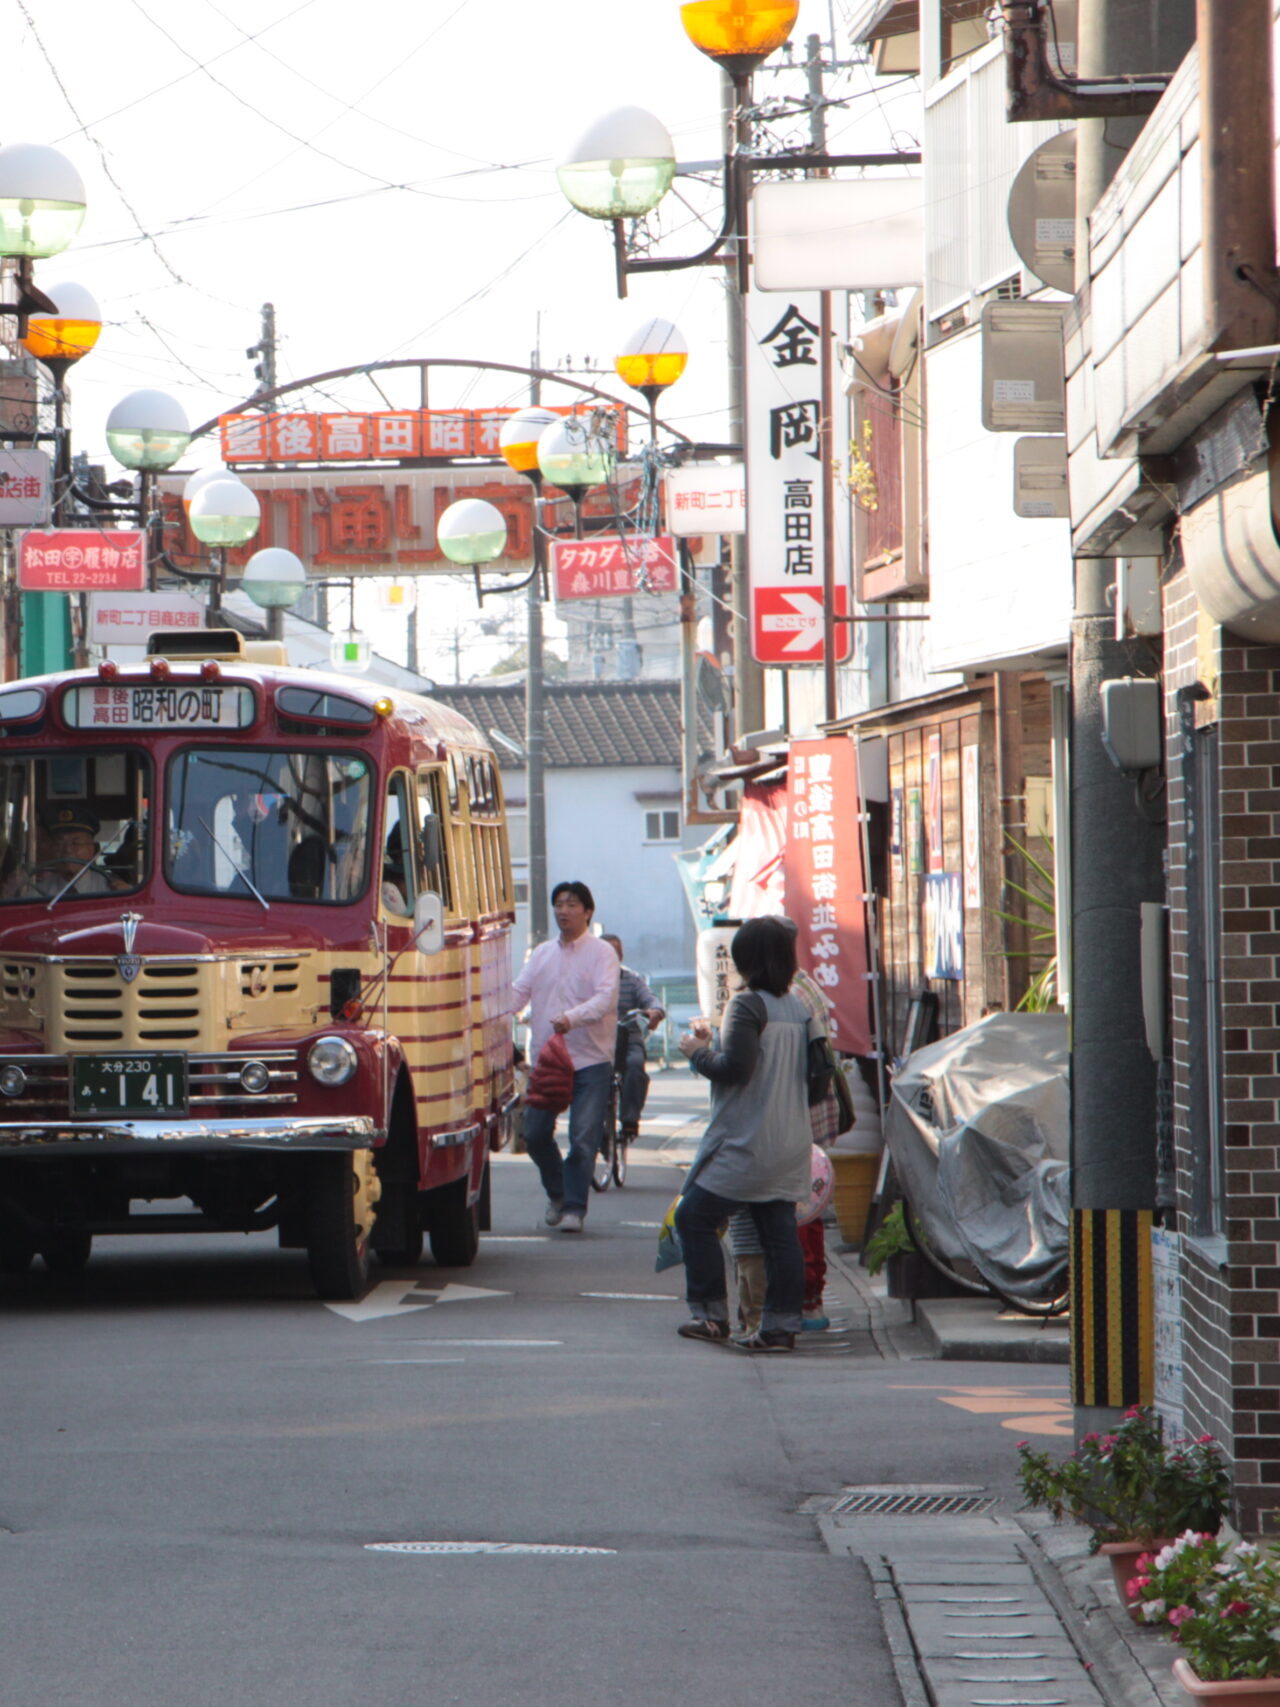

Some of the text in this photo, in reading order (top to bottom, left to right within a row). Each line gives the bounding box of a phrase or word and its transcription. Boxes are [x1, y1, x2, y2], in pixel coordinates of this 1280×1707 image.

[783, 479, 813, 576] 高田店
[47, 572, 117, 585] TEL 22-2234
[571, 564, 671, 593] 森川豊堂
[96, 608, 201, 627] 新町二丁目商店街
[93, 687, 129, 705] 豊後
[93, 707, 129, 724] 高田
[132, 689, 223, 724] 昭和の町
